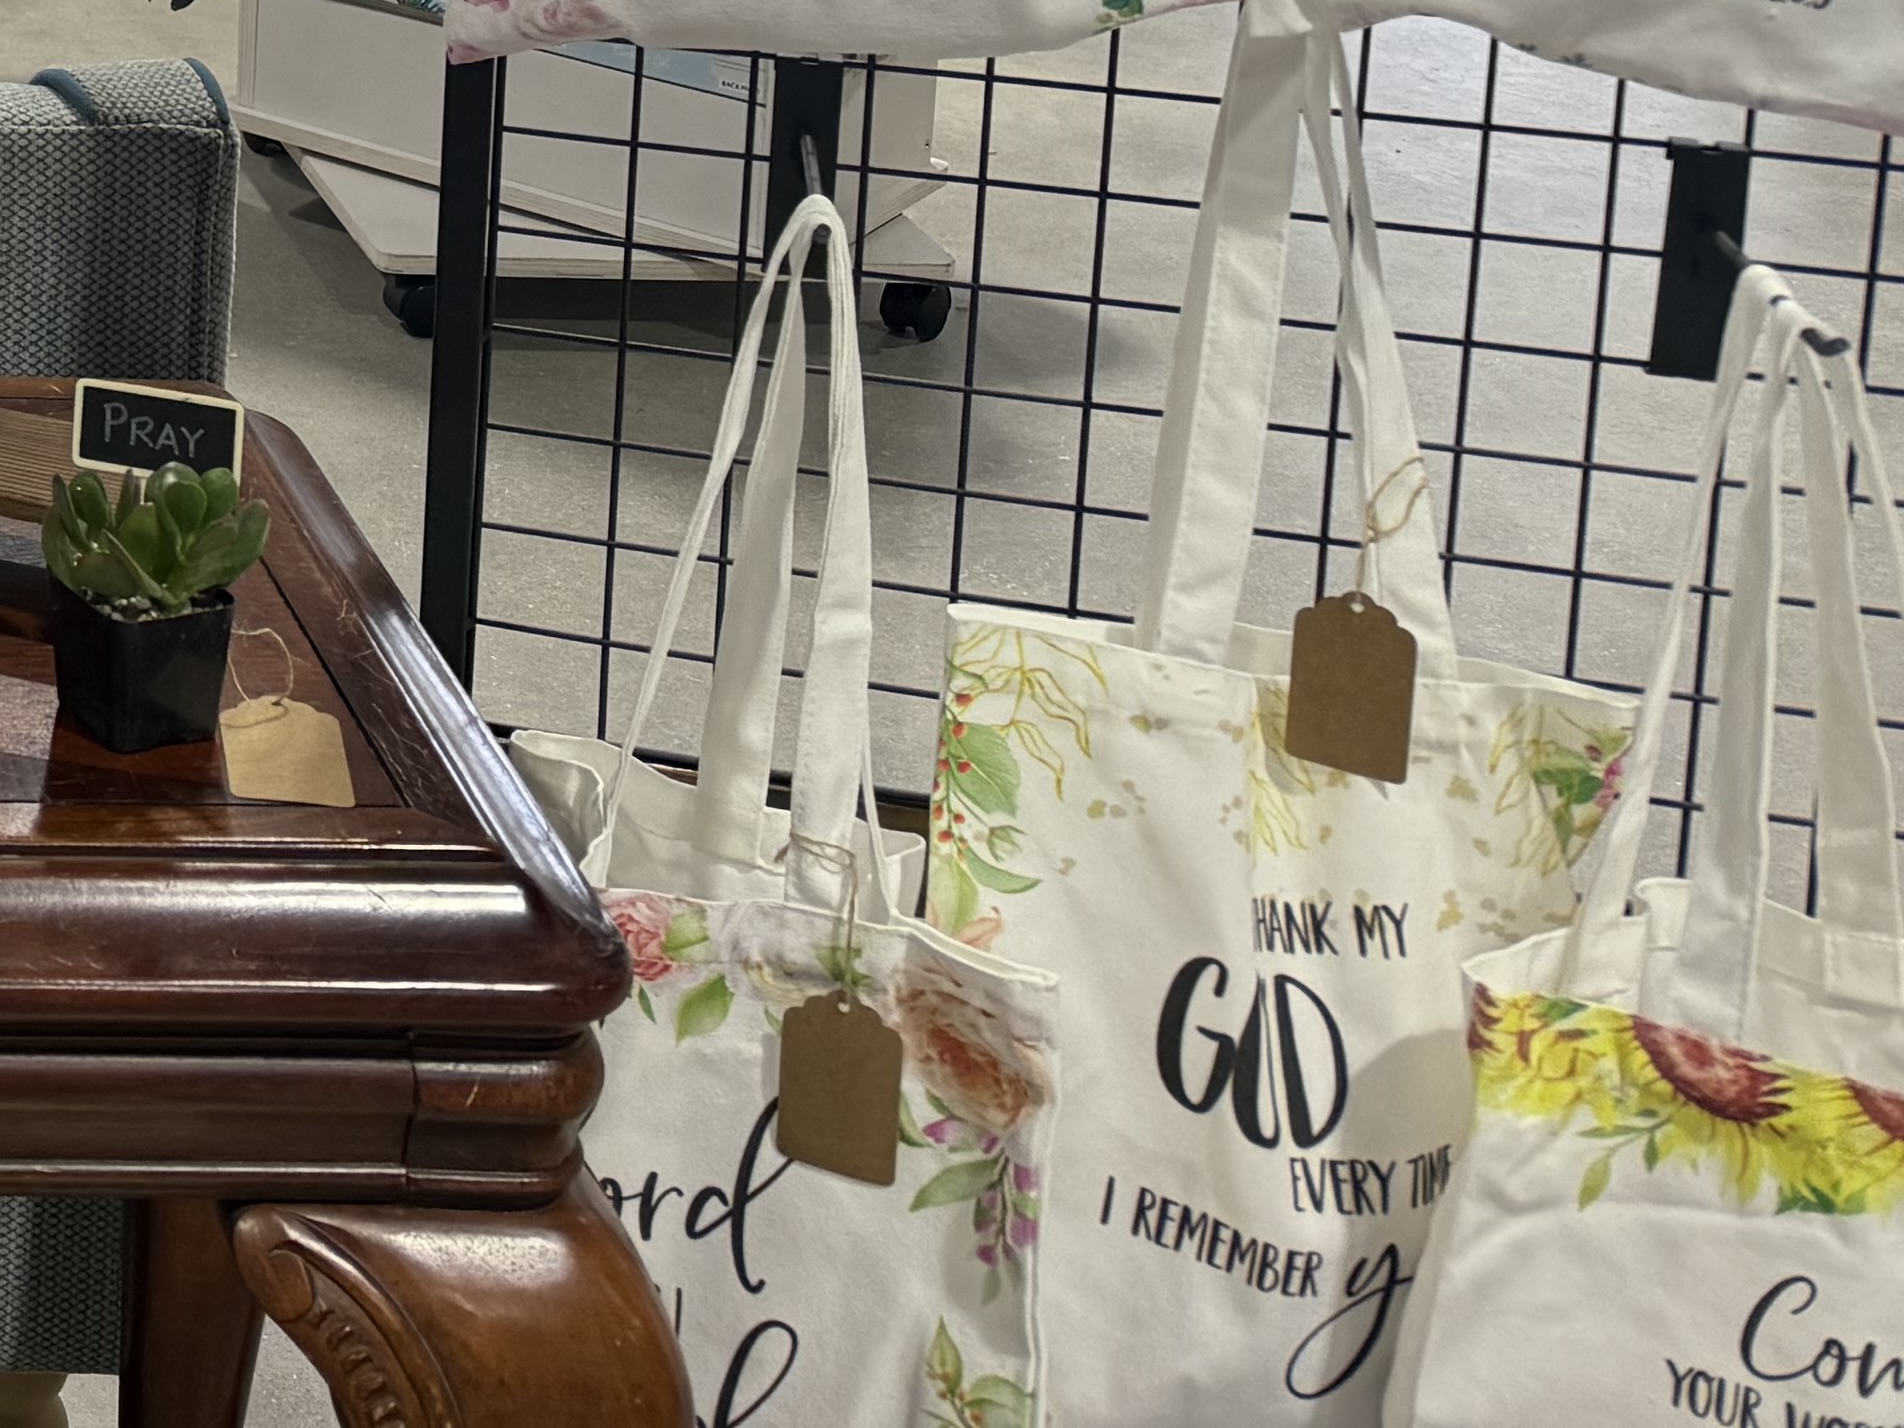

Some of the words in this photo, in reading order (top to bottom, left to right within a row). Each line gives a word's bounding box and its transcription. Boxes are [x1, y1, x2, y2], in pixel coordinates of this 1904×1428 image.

[100, 400, 203, 458] PRAY
[1355, 902, 1411, 959] MY
[1156, 955, 1350, 1151] GOD
[1291, 1160, 1396, 1217] EVERY
[1100, 1174, 1116, 1226] I
[1129, 1191, 1326, 1300] REMEMBER
